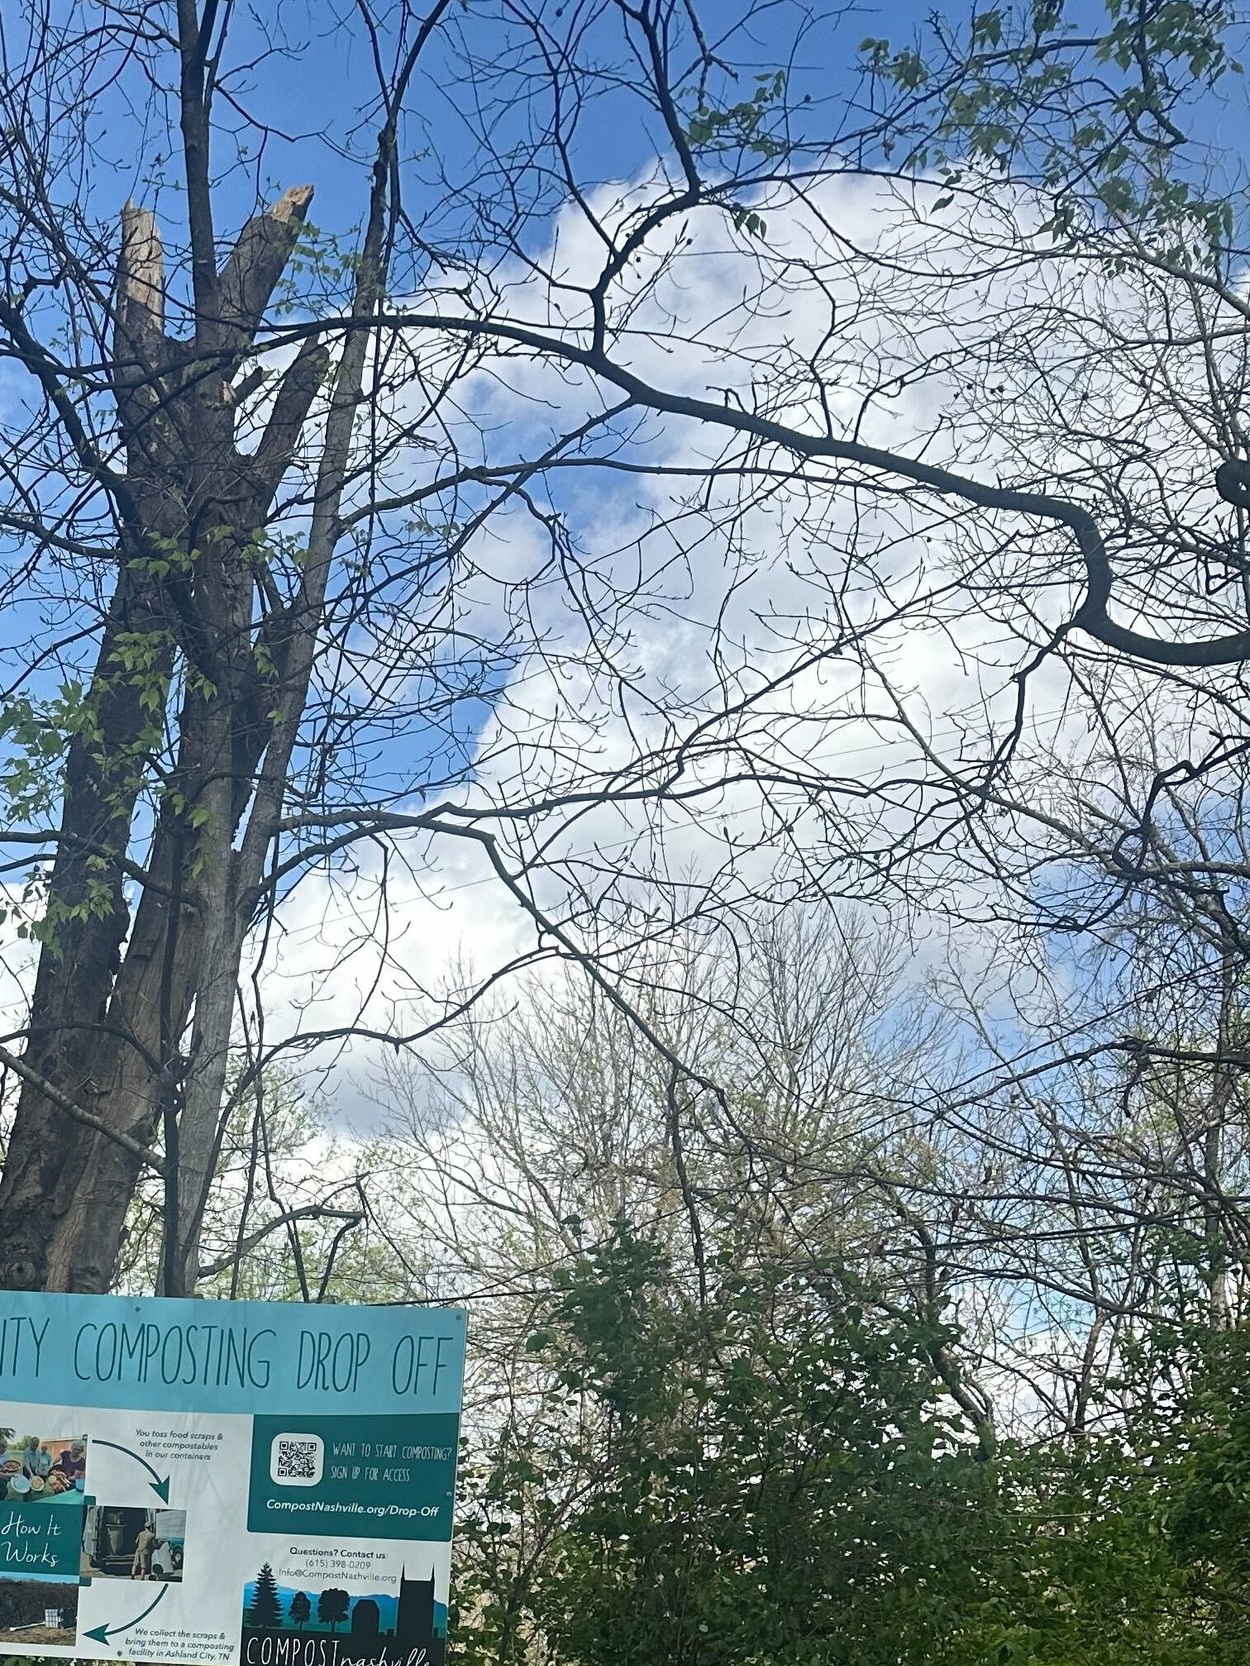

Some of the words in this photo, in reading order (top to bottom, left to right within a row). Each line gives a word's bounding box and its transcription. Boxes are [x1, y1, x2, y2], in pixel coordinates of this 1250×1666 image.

[73, 1322, 277, 1389] COMPOSTING
[296, 1330, 371, 1393] DROP
[392, 1335, 454, 1396] OFF
[135, 1429, 150, 1437] You
[151, 1430, 168, 1438] toss
[169, 1430, 189, 1439] food
[190, 1433, 215, 1441] scraps
[216, 1433, 224, 1441] &
[139, 1440, 161, 1448] other
[162, 1442, 218, 1451] compostables
[332, 1442, 356, 1457] WANT
[361, 1443, 371, 1457] TO
[375, 1443, 398, 1458] START
[402, 1445, 453, 1461] COMPOSTING?
[170, 1452, 211, 1461] containers
[330, 1465, 348, 1479] SIGN
[352, 1466, 361, 1480] UP
[365, 1467, 378, 1481] FOR
[382, 1468, 410, 1482] ACCESS
[266, 1499, 440, 1518] CompostNashville.org/Drop-Off
[1, 1511, 41, 1538] How
[46, 1514, 62, 1536] It
[0, 1540, 60, 1568] Works
[289, 1546, 338, 1557] Questions?
[340, 1549, 374, 1559] Contact
[305, 1559, 328, 1568] (615)
[330, 1560, 371, 1570] 398-0209
[135, 1628, 148, 1636] We
[150, 1629, 176, 1638] collect
[178, 1630, 191, 1638] the
[192, 1632, 217, 1640] scraps
[219, 1632, 226, 1640] &
[125, 1637, 146, 1647] bring
[148, 1638, 169, 1647] them
[170, 1640, 179, 1648] to
[187, 1642, 235, 1652] composting
[128, 1648, 154, 1658] facility
[164, 1650, 197, 1659] Ashland
[199, 1651, 217, 1661] City,
[218, 1653, 230, 1661] TN
